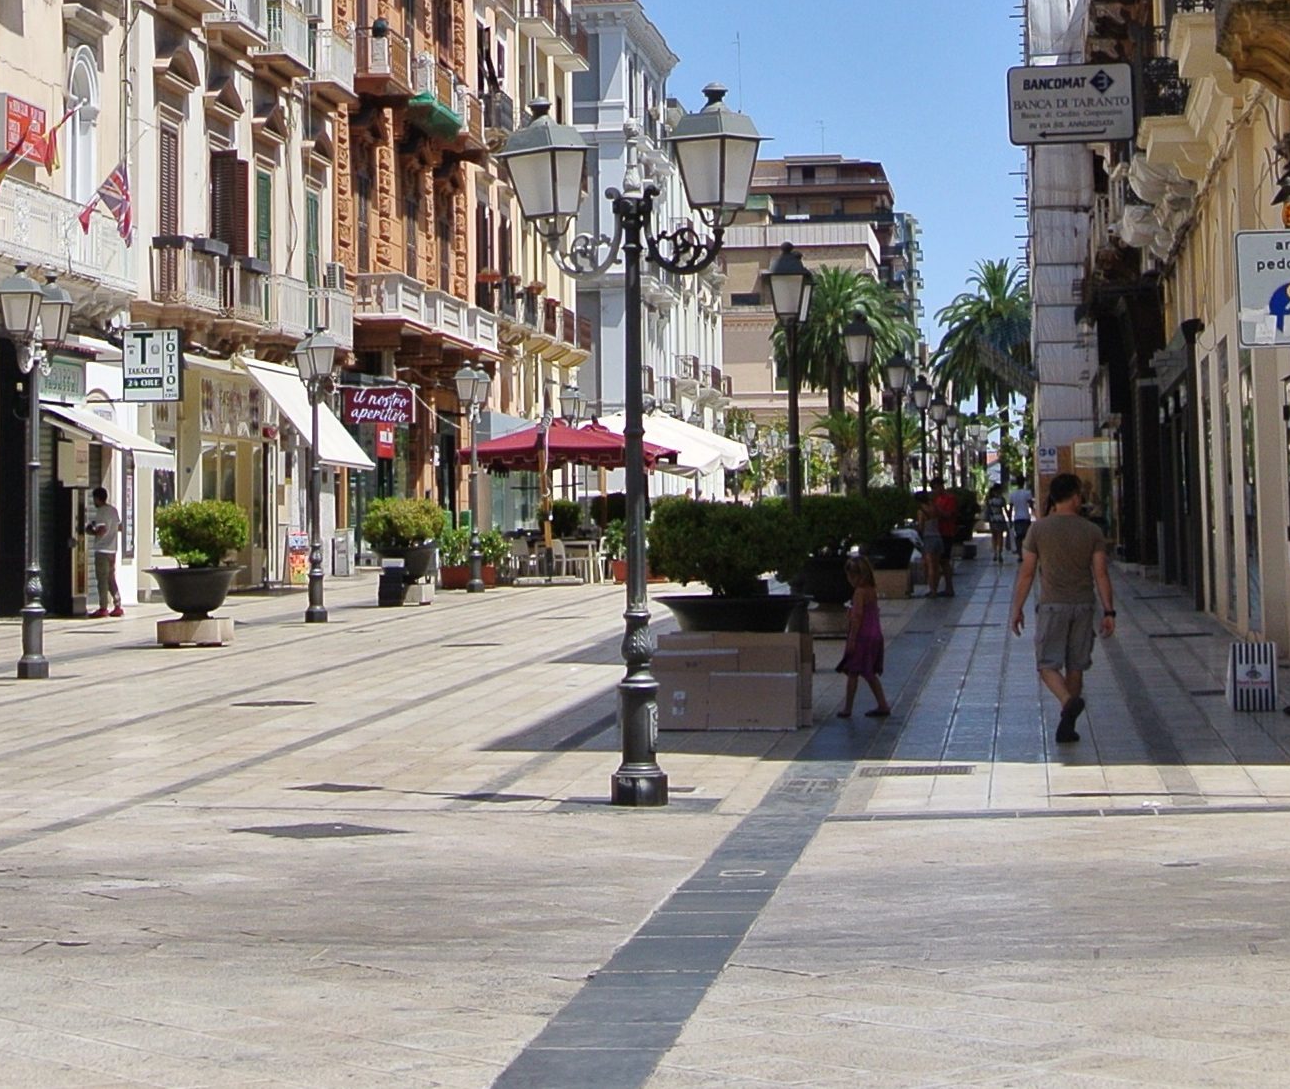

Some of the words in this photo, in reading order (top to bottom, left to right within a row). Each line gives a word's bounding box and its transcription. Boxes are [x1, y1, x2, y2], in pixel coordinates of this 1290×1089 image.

[1023, 77, 1087, 91] BANCOMAT
[1013, 99, 1052, 111] BANCA
[1057, 98, 1068, 109] DI
[1071, 95, 1130, 108] TARANTO
[133, 333, 154, 365] T
[165, 332, 177, 386] LOTTO
[127, 367, 160, 375] TABACCHI
[127, 378, 139, 388] 24
[140, 378, 160, 387] ORE
[353, 388, 367, 403] il
[368, 392, 410, 409] nostro
[350, 408, 409, 425] aperitivo
